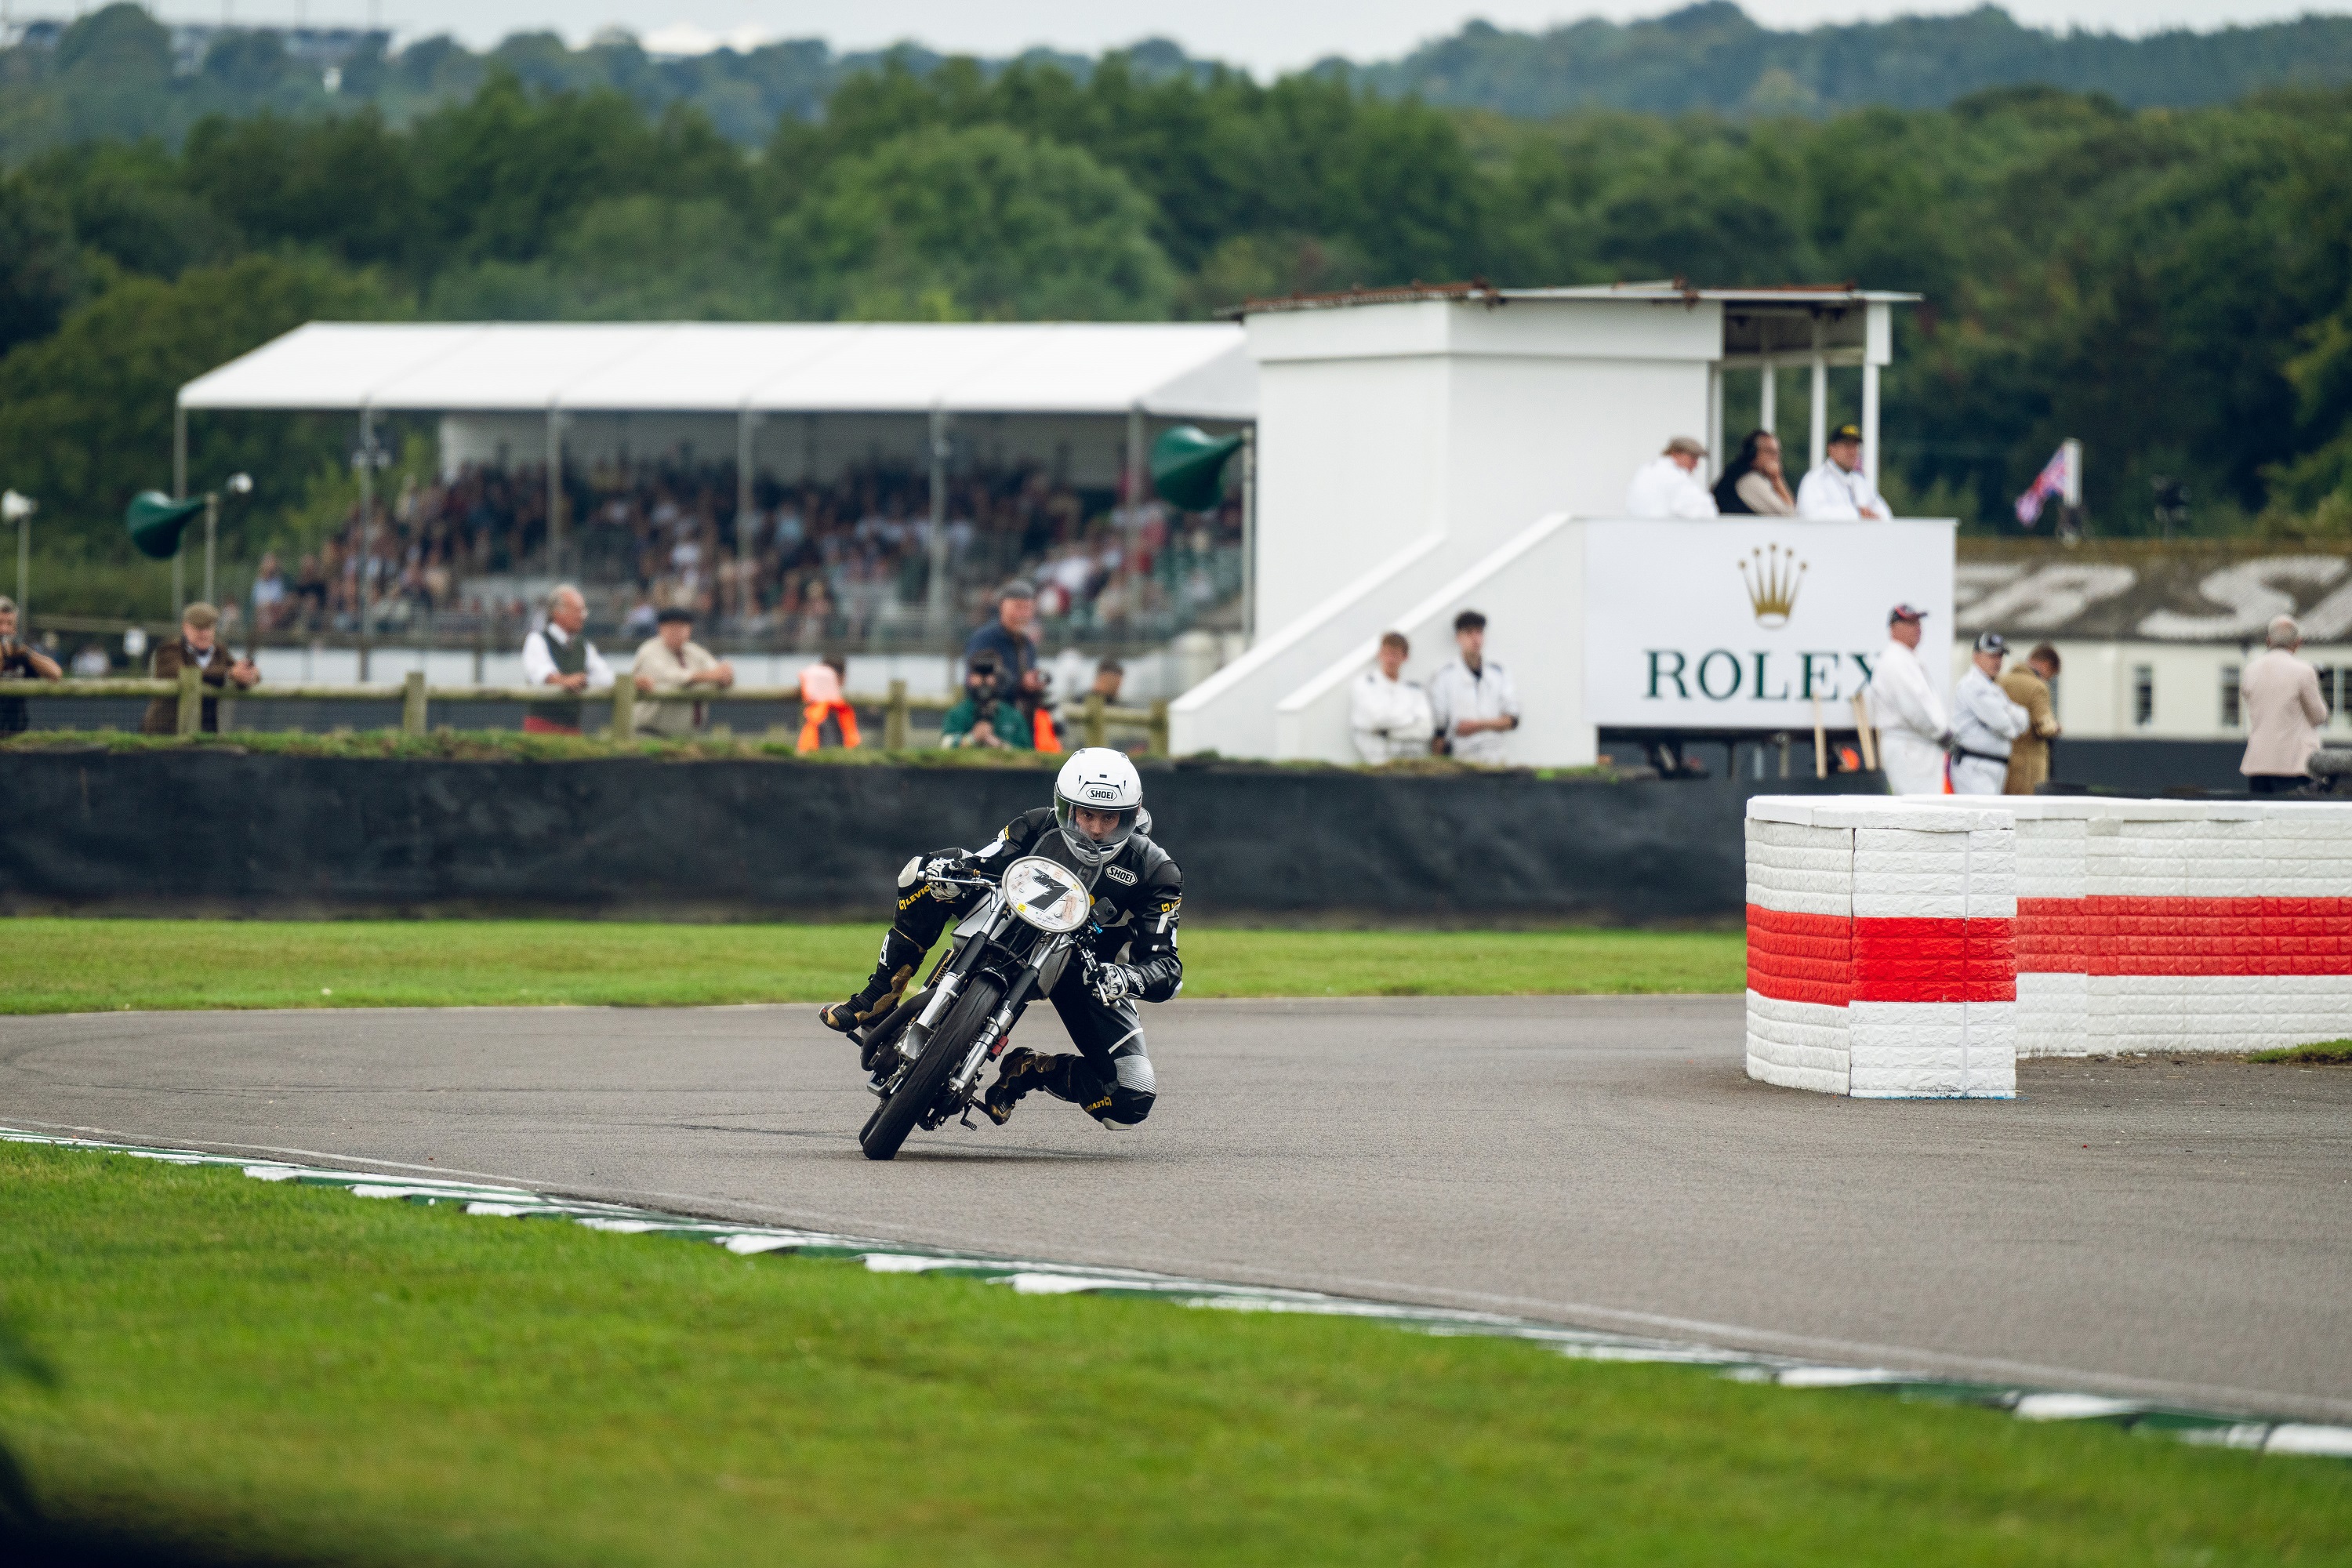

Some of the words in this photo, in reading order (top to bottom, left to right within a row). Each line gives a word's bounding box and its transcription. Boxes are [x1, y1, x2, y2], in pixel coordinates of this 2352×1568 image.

[1090, 789, 1113, 800] SHOEI
[1109, 867, 1133, 883] SHOEI
[1025, 867, 1073, 913] 7
